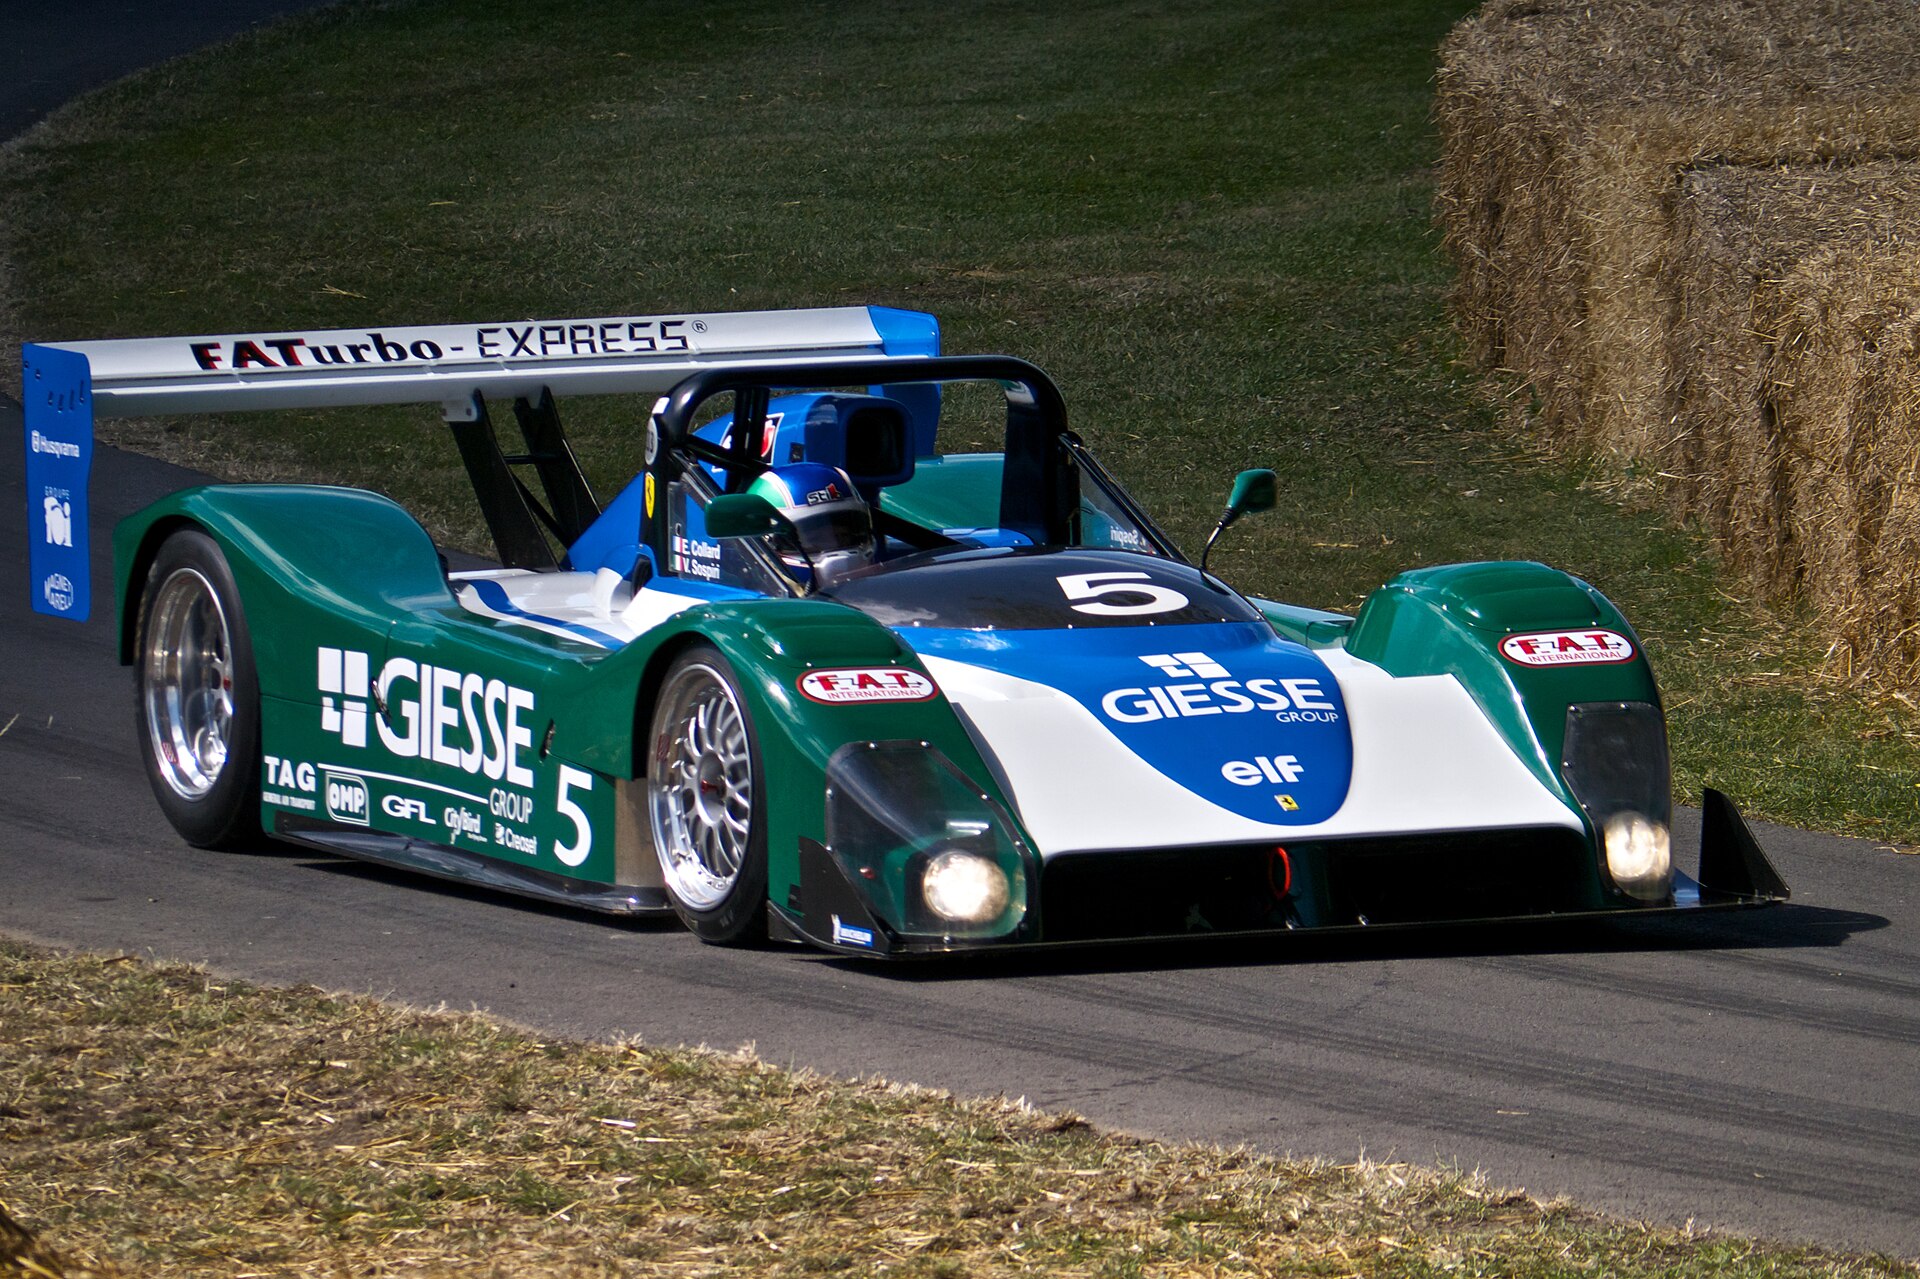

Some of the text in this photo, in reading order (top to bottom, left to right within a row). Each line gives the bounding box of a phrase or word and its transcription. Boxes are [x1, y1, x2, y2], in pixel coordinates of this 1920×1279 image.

[691, 539, 721, 560] Collard
[691, 558, 720, 581] Sospiri
[1056, 572, 1189, 616] 5
[1528, 649, 1624, 663] INTERNATIONAL
[827, 688, 926, 700] INTERNATIONAL
[1101, 677, 1336, 723] GIESSE
[375, 657, 534, 788] GIESSE
[1275, 710, 1340, 724] GROUP
[264, 755, 316, 792] TAG
[1221, 754, 1305, 786] elf
[328, 782, 365, 813] OMP
[381, 794, 437, 825] GFL
[489, 787, 533, 824] GROUP
[554, 764, 592, 866] 5
